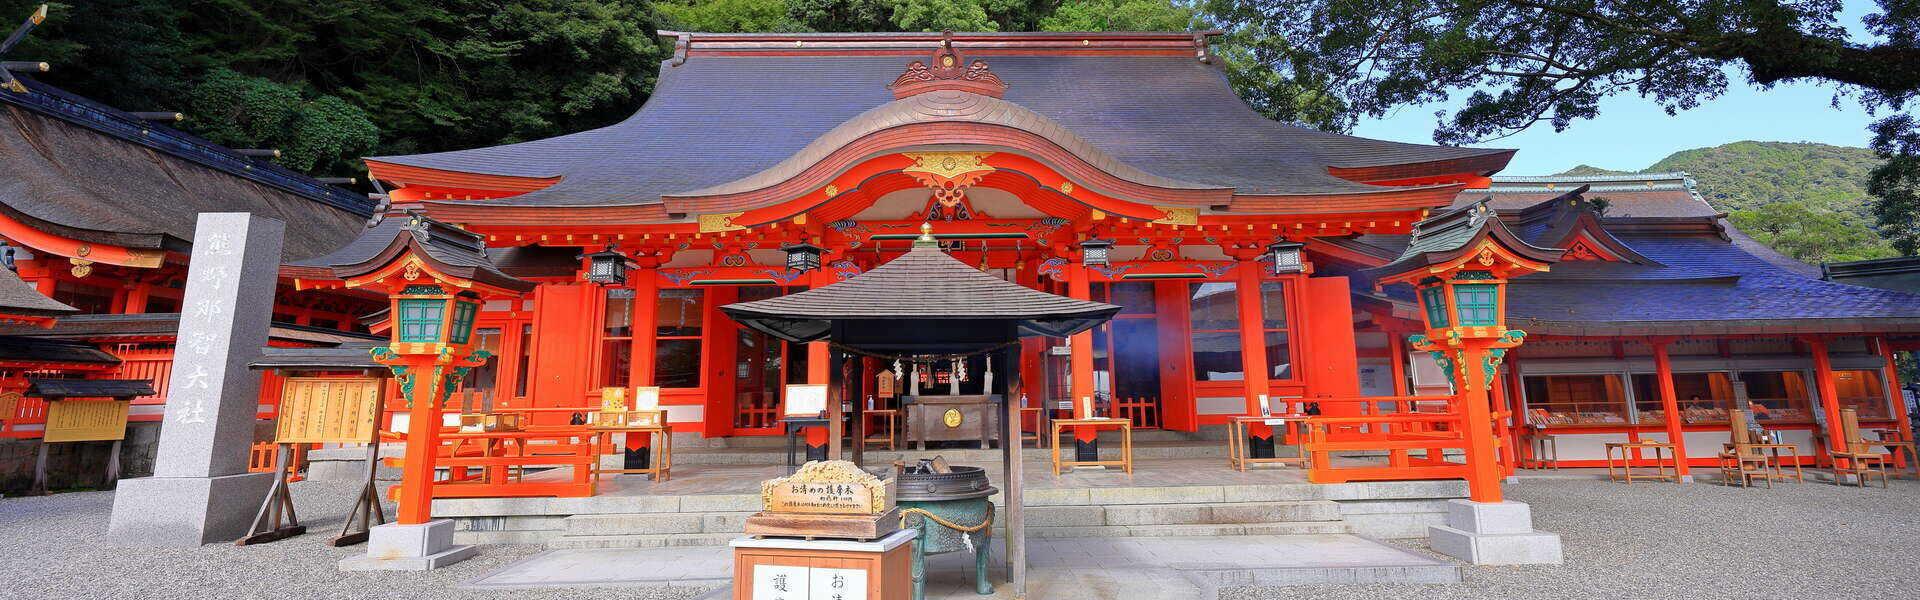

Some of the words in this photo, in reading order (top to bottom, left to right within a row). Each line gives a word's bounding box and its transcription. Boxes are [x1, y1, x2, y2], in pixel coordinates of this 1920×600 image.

[176, 232, 232, 425] 熊野那智大社
[791, 484, 854, 496] お清めの護摩木
[773, 574, 788, 600] 護
